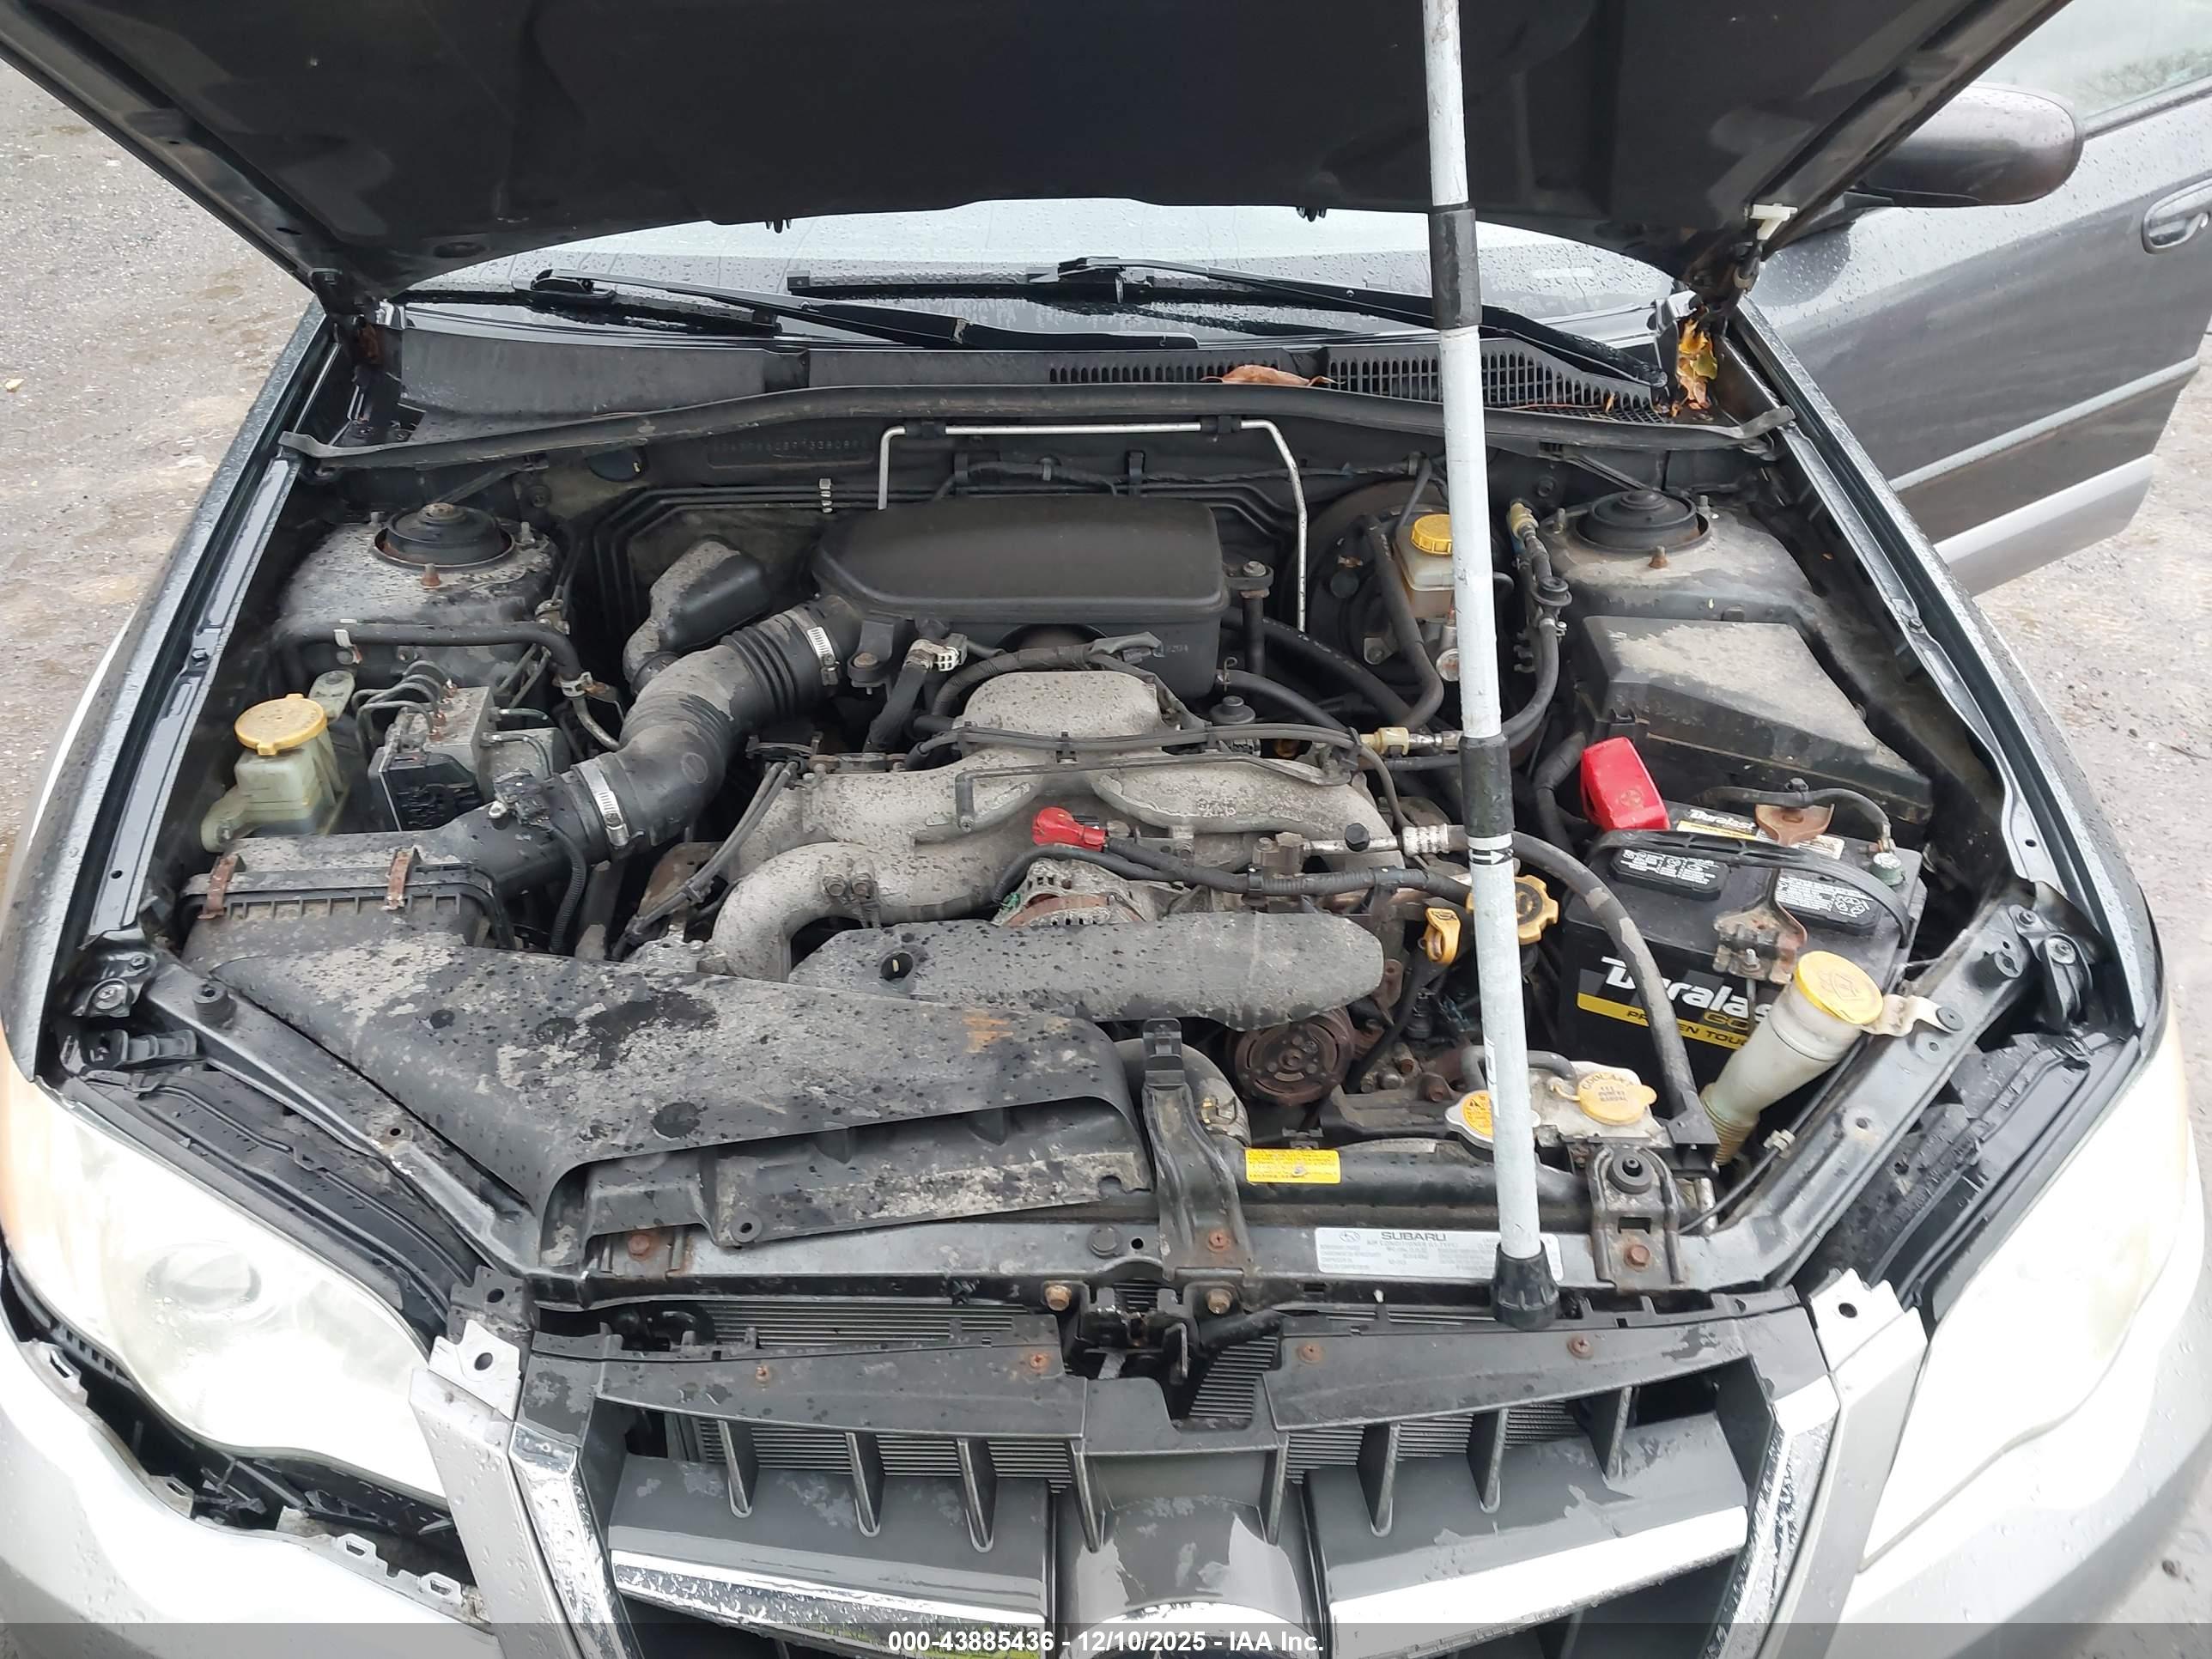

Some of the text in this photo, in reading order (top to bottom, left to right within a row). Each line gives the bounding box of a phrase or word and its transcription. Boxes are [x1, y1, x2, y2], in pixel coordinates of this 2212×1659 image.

[1601, 956, 1772, 1022] Dralas
[1706, 1030, 1747, 1046] TOU
[1381, 1231, 1446, 1242] SUBARU
